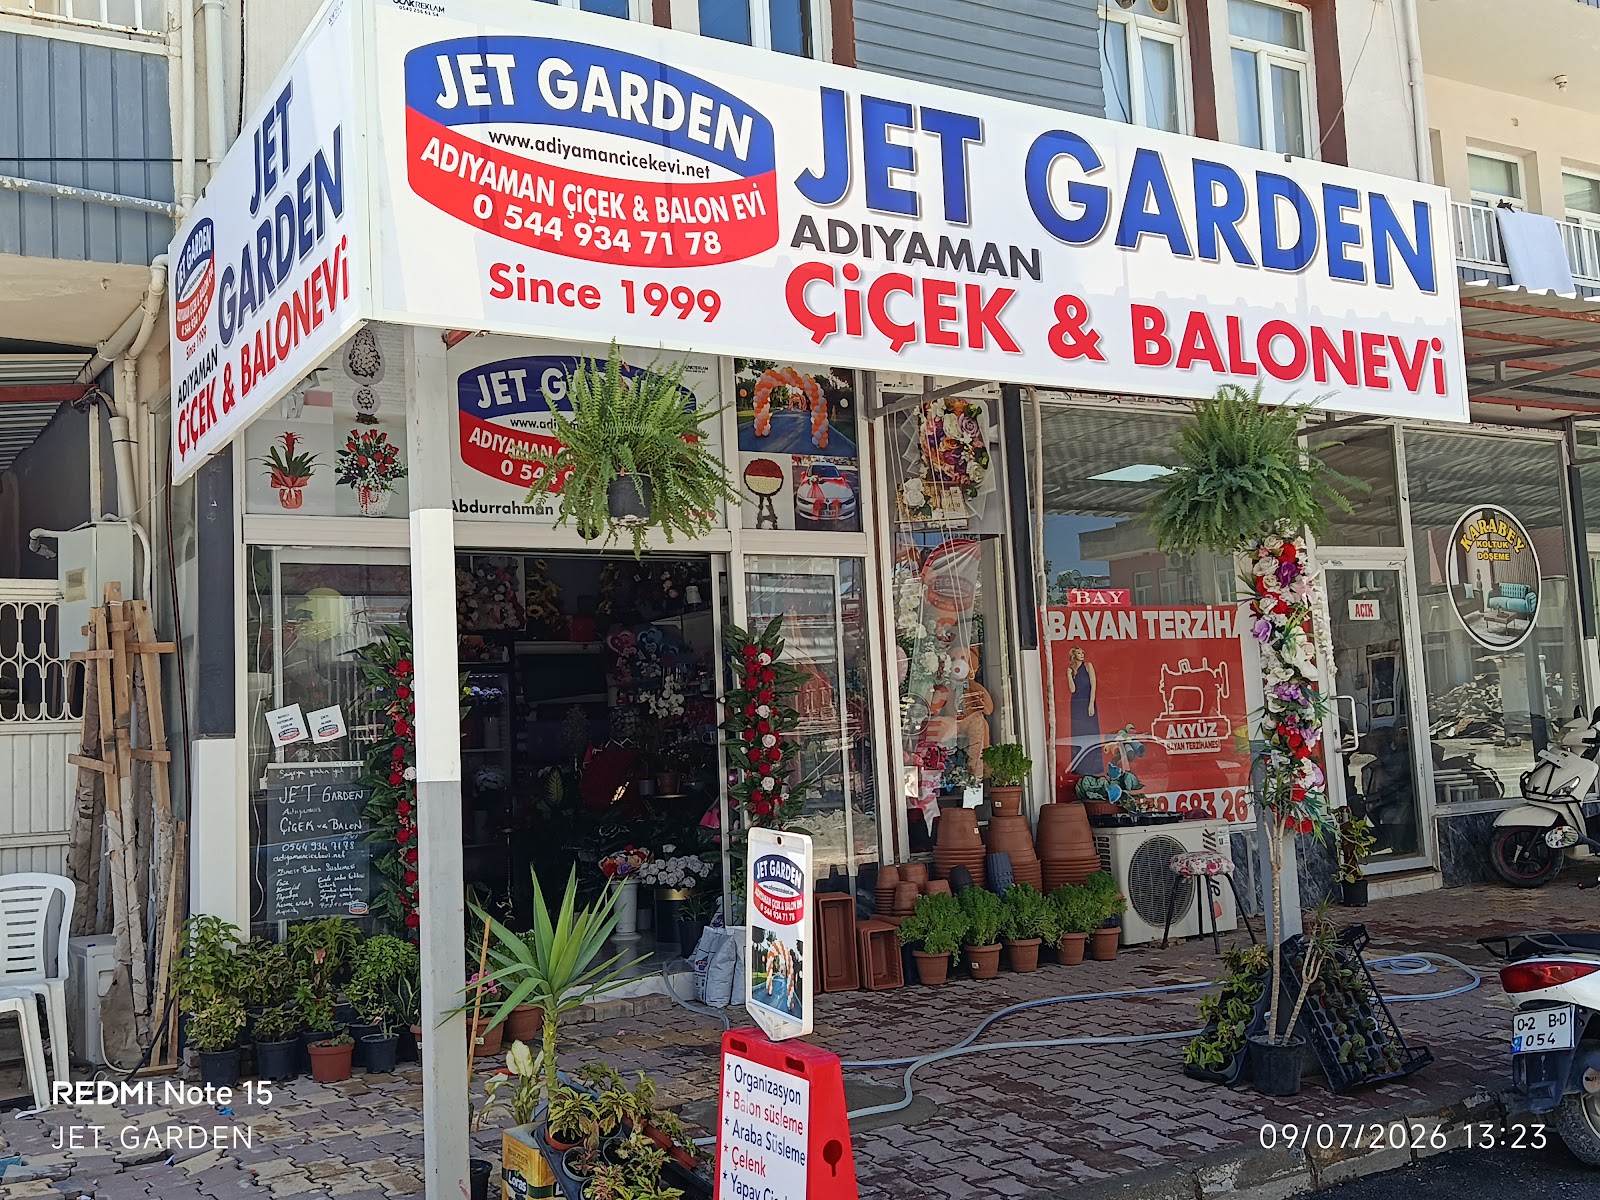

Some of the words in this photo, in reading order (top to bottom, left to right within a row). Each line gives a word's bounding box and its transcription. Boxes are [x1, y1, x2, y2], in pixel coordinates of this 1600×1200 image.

[436, 53, 516, 110] JET
[537, 57, 753, 162] GARDEN
[250, 78, 292, 216] JET
[488, 131, 711, 180] www.adiyamancicekevi.net
[420, 136, 556, 207] ADIYAMAN
[632, 195, 650, 222] &
[654, 196, 730, 224] BALON
[793, 86, 983, 225] JET
[1024, 129, 1437, 294] GARDEN
[219, 122, 343, 346] GARDEN
[473, 193, 494, 220] 0
[503, 204, 564, 242] 544
[573, 222, 632, 253] 934
[640, 231, 674, 256] 71
[684, 231, 722, 255] 78
[186, 224, 212, 270] GARDEN
[790, 214, 1041, 281] ADIYAMAN
[489, 262, 601, 310] Since
[620, 279, 722, 323] 1999
[1047, 294, 1106, 362] &
[177, 344, 218, 409] ADIYAMAN
[222, 362, 236, 416] &
[477, 369, 527, 409] JET
[500, 459, 514, 476] 0
[1460, 518, 1526, 554] KARABEY
[1476, 540, 1509, 550] KOLTUK
[1477, 551, 1511, 562] DÖŞEME
[1075, 591, 1125, 605] BAY
[1355, 603, 1374, 618] AÇIK
[1047, 610, 1138, 641] BAYAN
[1166, 719, 1218, 739] AKYÜZ
[279, 783, 317, 804] JET
[1221, 789, 1248, 822] 26
[328, 819, 362, 830] BALON
[282, 843, 307, 852] 0544
[311, 842, 328, 851] 934
[757, 861, 768, 879] JET
[769, 860, 802, 889] GARDEN
[1517, 1017, 1536, 1031] 02
[1526, 1032, 1555, 1047] 054
[734, 1064, 801, 1106] Organizasyon
[733, 1091, 761, 1118] Balon
[764, 1104, 803, 1136] süsleme
[731, 1146, 766, 1177] Çelenk
[732, 1119, 762, 1147] Araba
[765, 1131, 806, 1166] Süsleme
[508, 1171, 526, 1192] Loras
